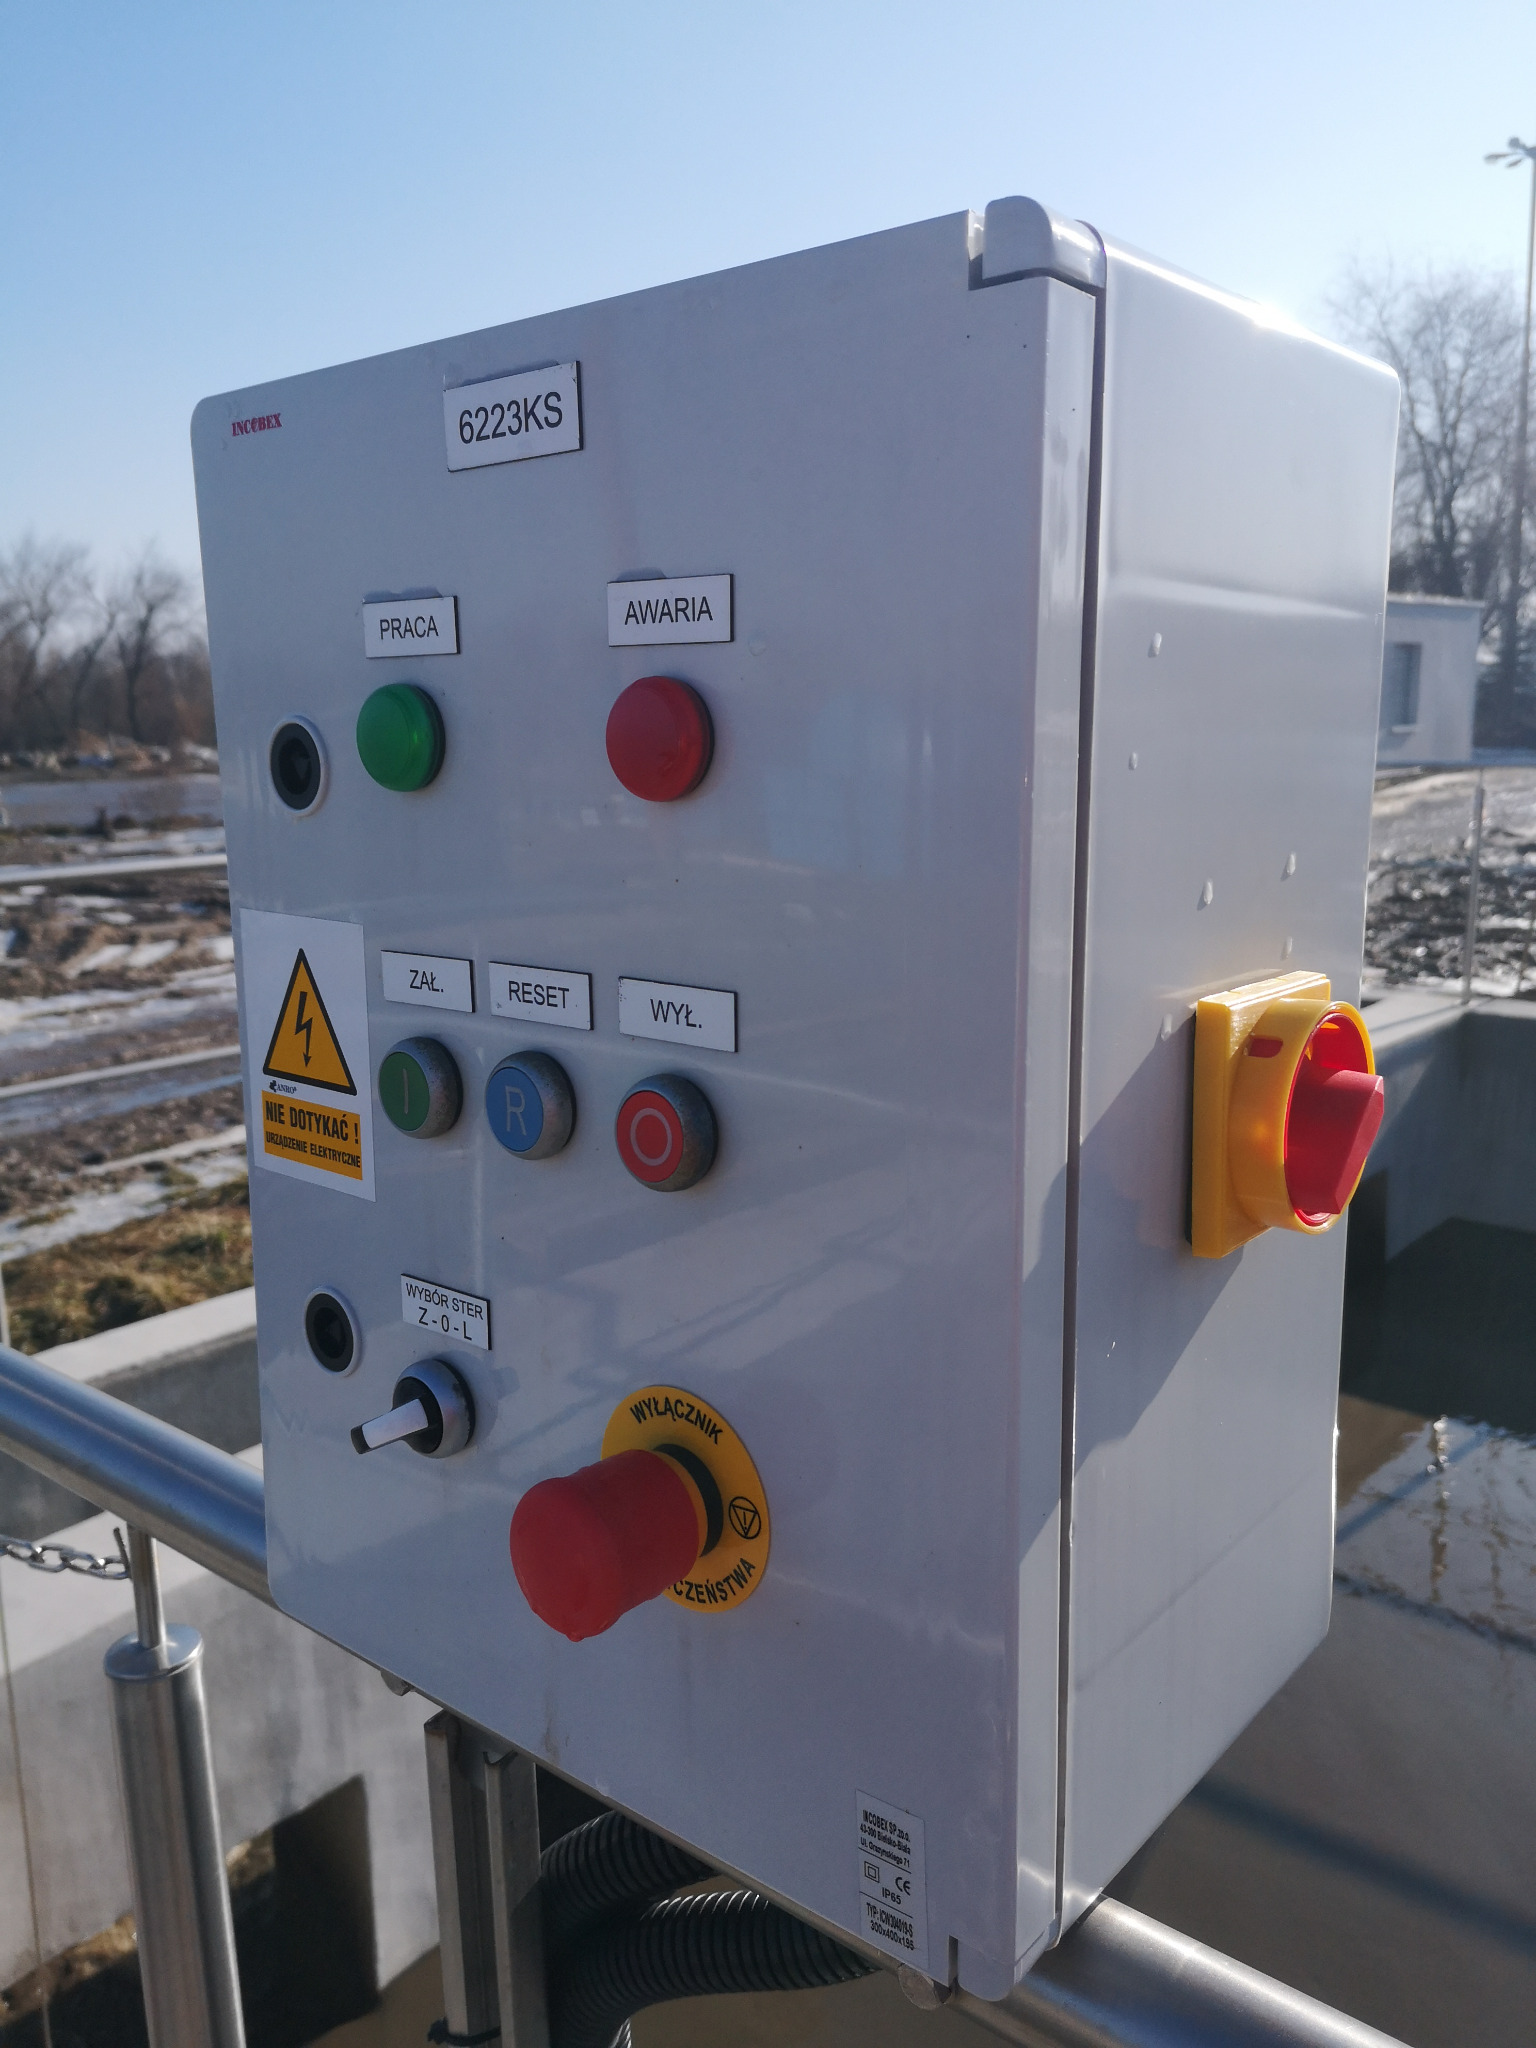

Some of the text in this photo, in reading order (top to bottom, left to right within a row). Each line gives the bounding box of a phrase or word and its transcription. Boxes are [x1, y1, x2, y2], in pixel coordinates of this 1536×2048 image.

[231, 413, 283, 437] INCOBEX
[459, 391, 563, 444] 6223KS
[379, 615, 439, 641] PRACA
[624, 596, 713, 626] AWARIA
[409, 969, 445, 993] ZAŁ.
[507, 980, 570, 1009] RESET
[650, 998, 703, 1030] WYŁ.
[265, 1100, 359, 1145] NIE DOTYKAĆ !
[505, 1085, 527, 1136] R
[265, 1131, 361, 1168] URZĄDZENIE ELEKTRYCZNE
[405, 1282, 484, 1321] WYBÓR STER
[629, 1396, 723, 1445] WYŁĄCZNIK
[668, 1557, 756, 1605] CZEŃSTWA
[882, 1887, 902, 1905] IP65
